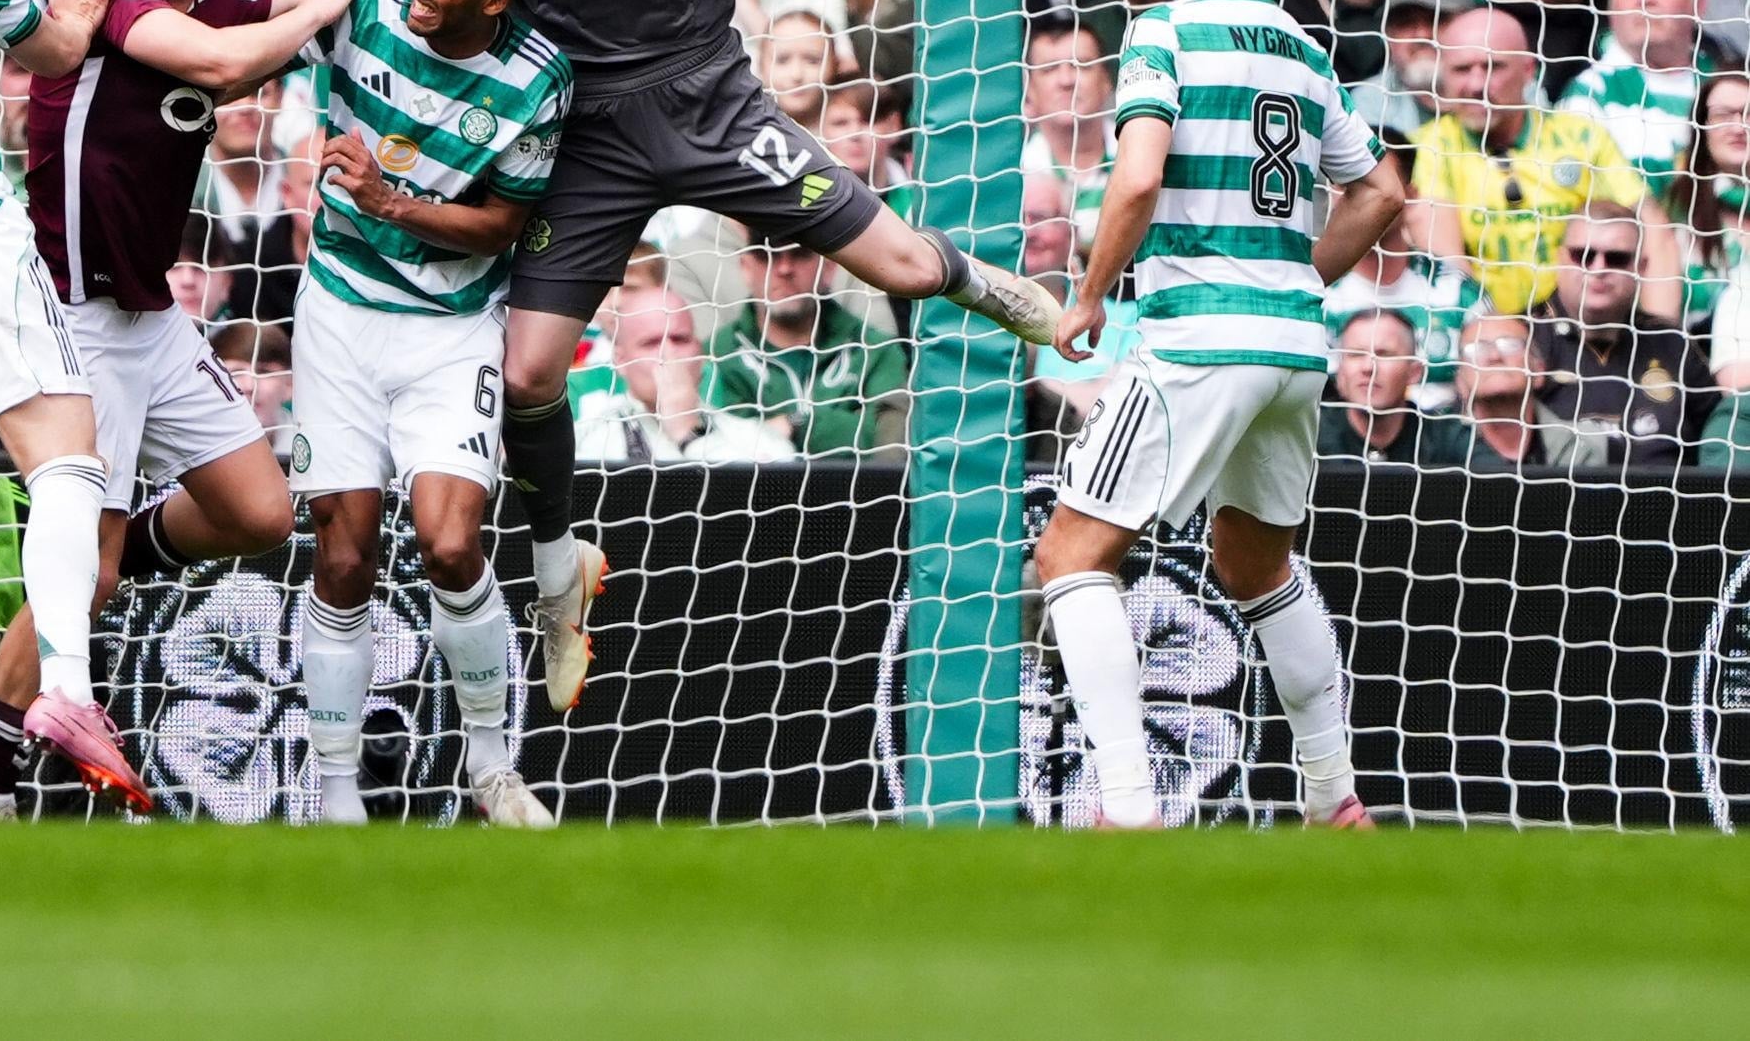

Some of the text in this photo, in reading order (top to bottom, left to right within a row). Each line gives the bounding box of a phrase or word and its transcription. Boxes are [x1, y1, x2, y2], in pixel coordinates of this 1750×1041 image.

[1228, 25, 1306, 61] NYGREN
[738, 125, 812, 187] 12
[1249, 89, 1302, 221] 8
[474, 364, 500, 419] 6
[461, 665, 500, 681] CELTIC
[310, 707, 348, 722] CELTIC
